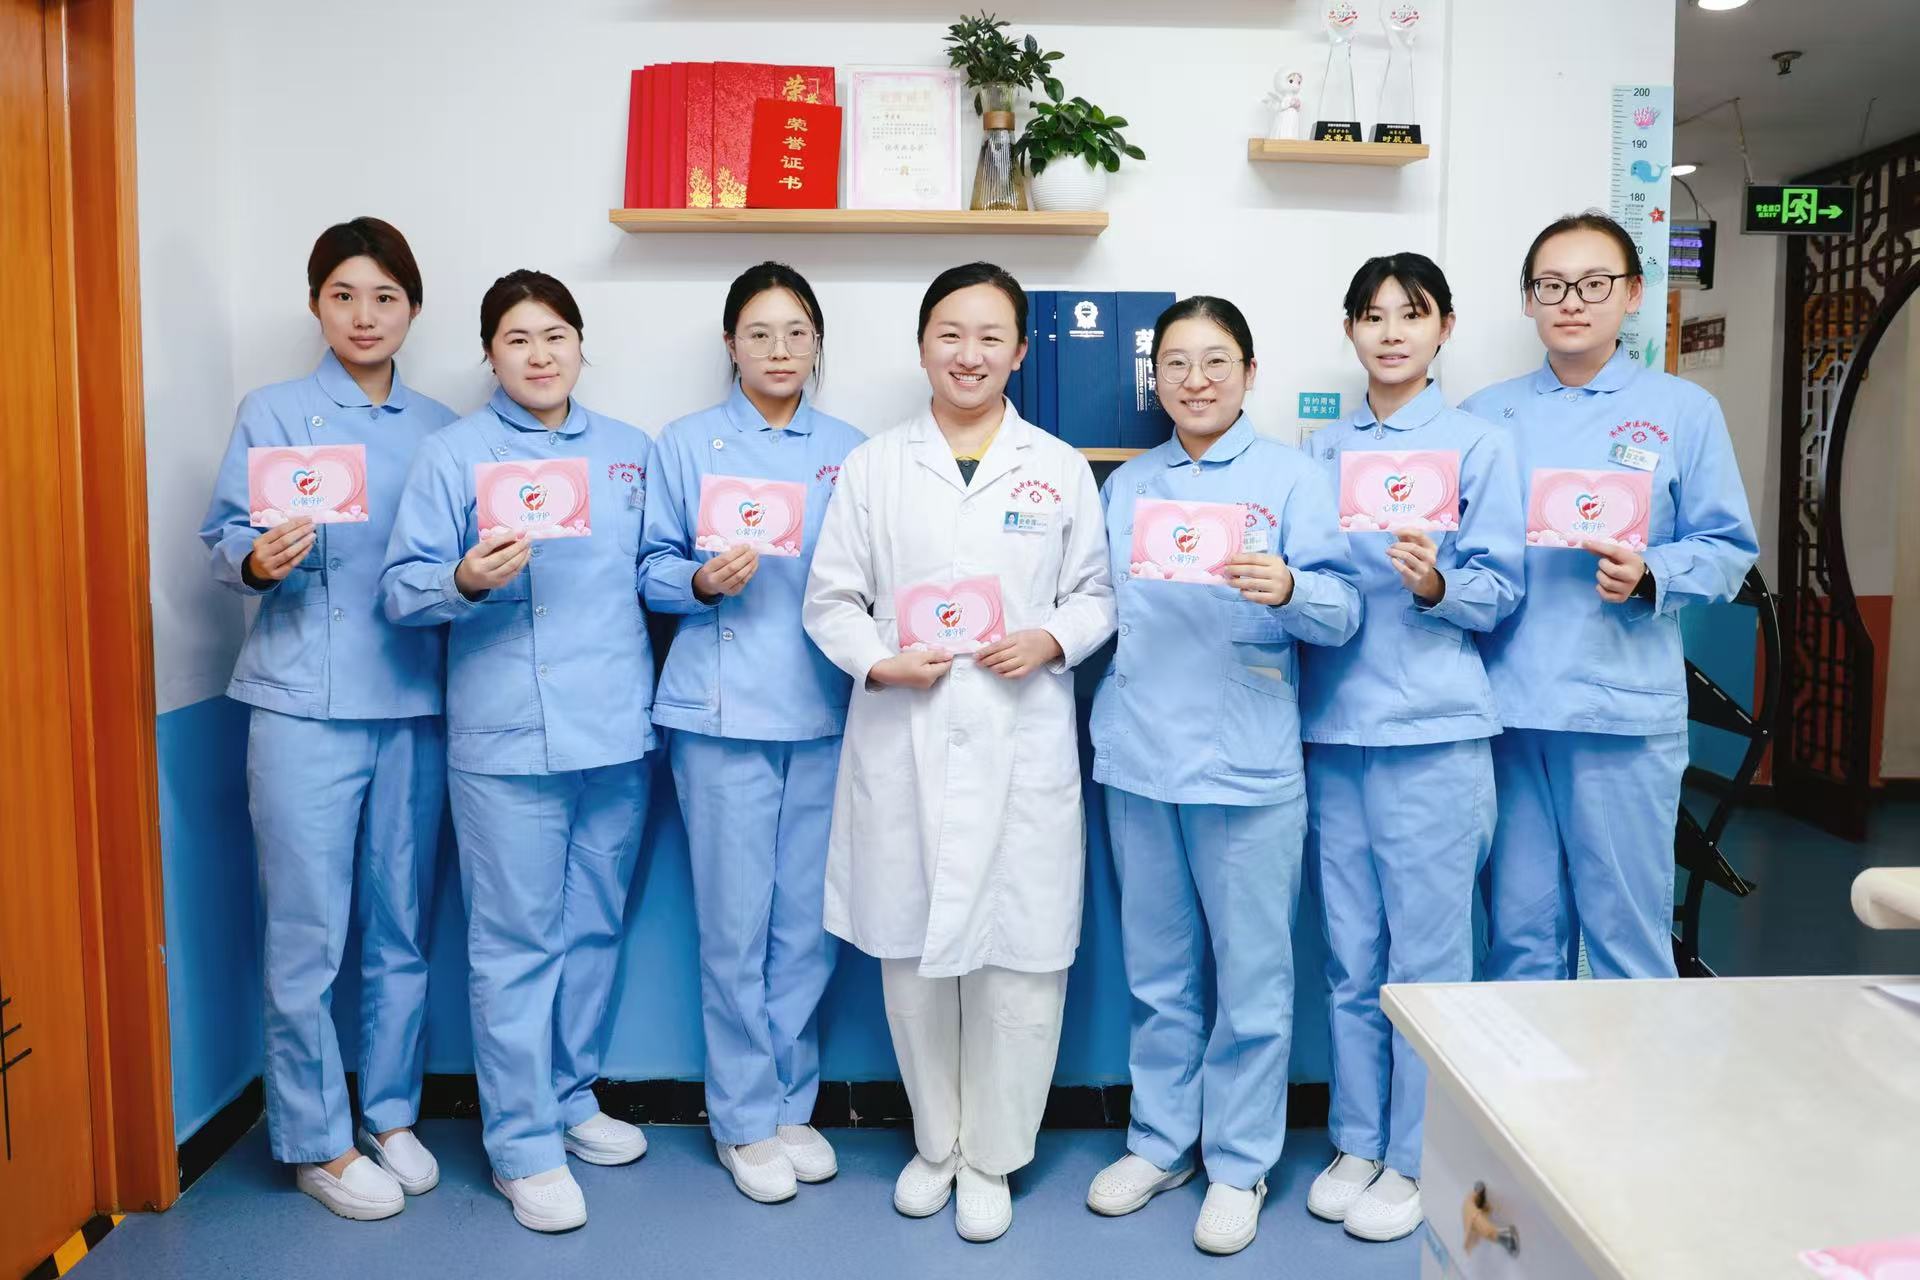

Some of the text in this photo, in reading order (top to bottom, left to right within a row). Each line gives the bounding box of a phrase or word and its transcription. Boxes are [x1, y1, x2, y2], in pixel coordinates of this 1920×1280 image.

[1633, 87, 1650, 97] 200
[1632, 139, 1648, 149] 190
[778, 117, 808, 190] 荣誉证书
[1630, 192, 1646, 202] 180
[1629, 350, 1640, 360] 50
[1303, 397, 1336, 406] 节约用电
[1303, 406, 1336, 414] 随手关灯
